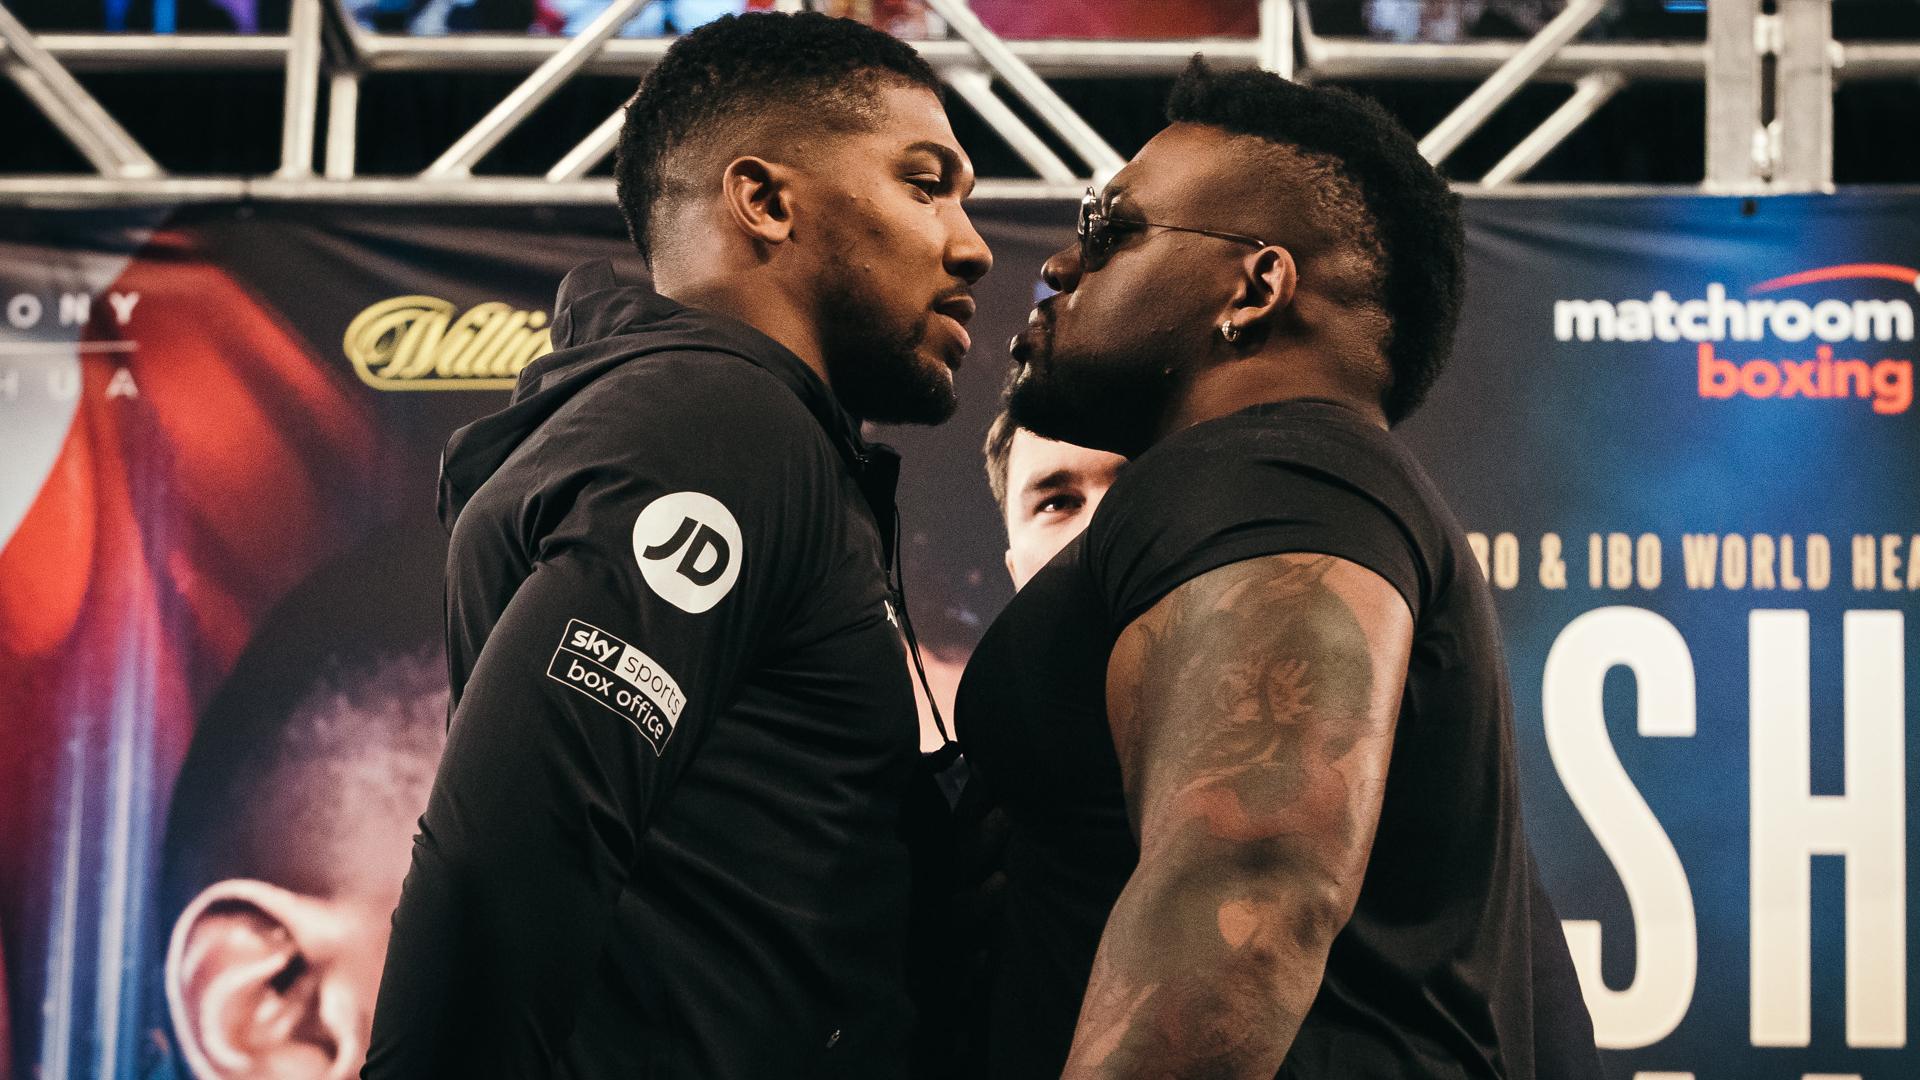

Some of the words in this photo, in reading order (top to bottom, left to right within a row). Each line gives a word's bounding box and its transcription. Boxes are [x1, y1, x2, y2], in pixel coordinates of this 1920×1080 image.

[6, 291, 140, 328] ONY
[1553, 282, 1915, 342] matchroom
[1698, 342, 1914, 415] boxing
[642, 516, 731, 587] JD
[1539, 532, 1567, 590] &
[1588, 532, 1662, 590] IBO
[1682, 533, 1832, 591] WORLD
[567, 659, 614, 697] box
[616, 690, 664, 740] office
[571, 630, 620, 662] sky
[624, 656, 680, 716] sports
[1542, 605, 1906, 1049] SH
